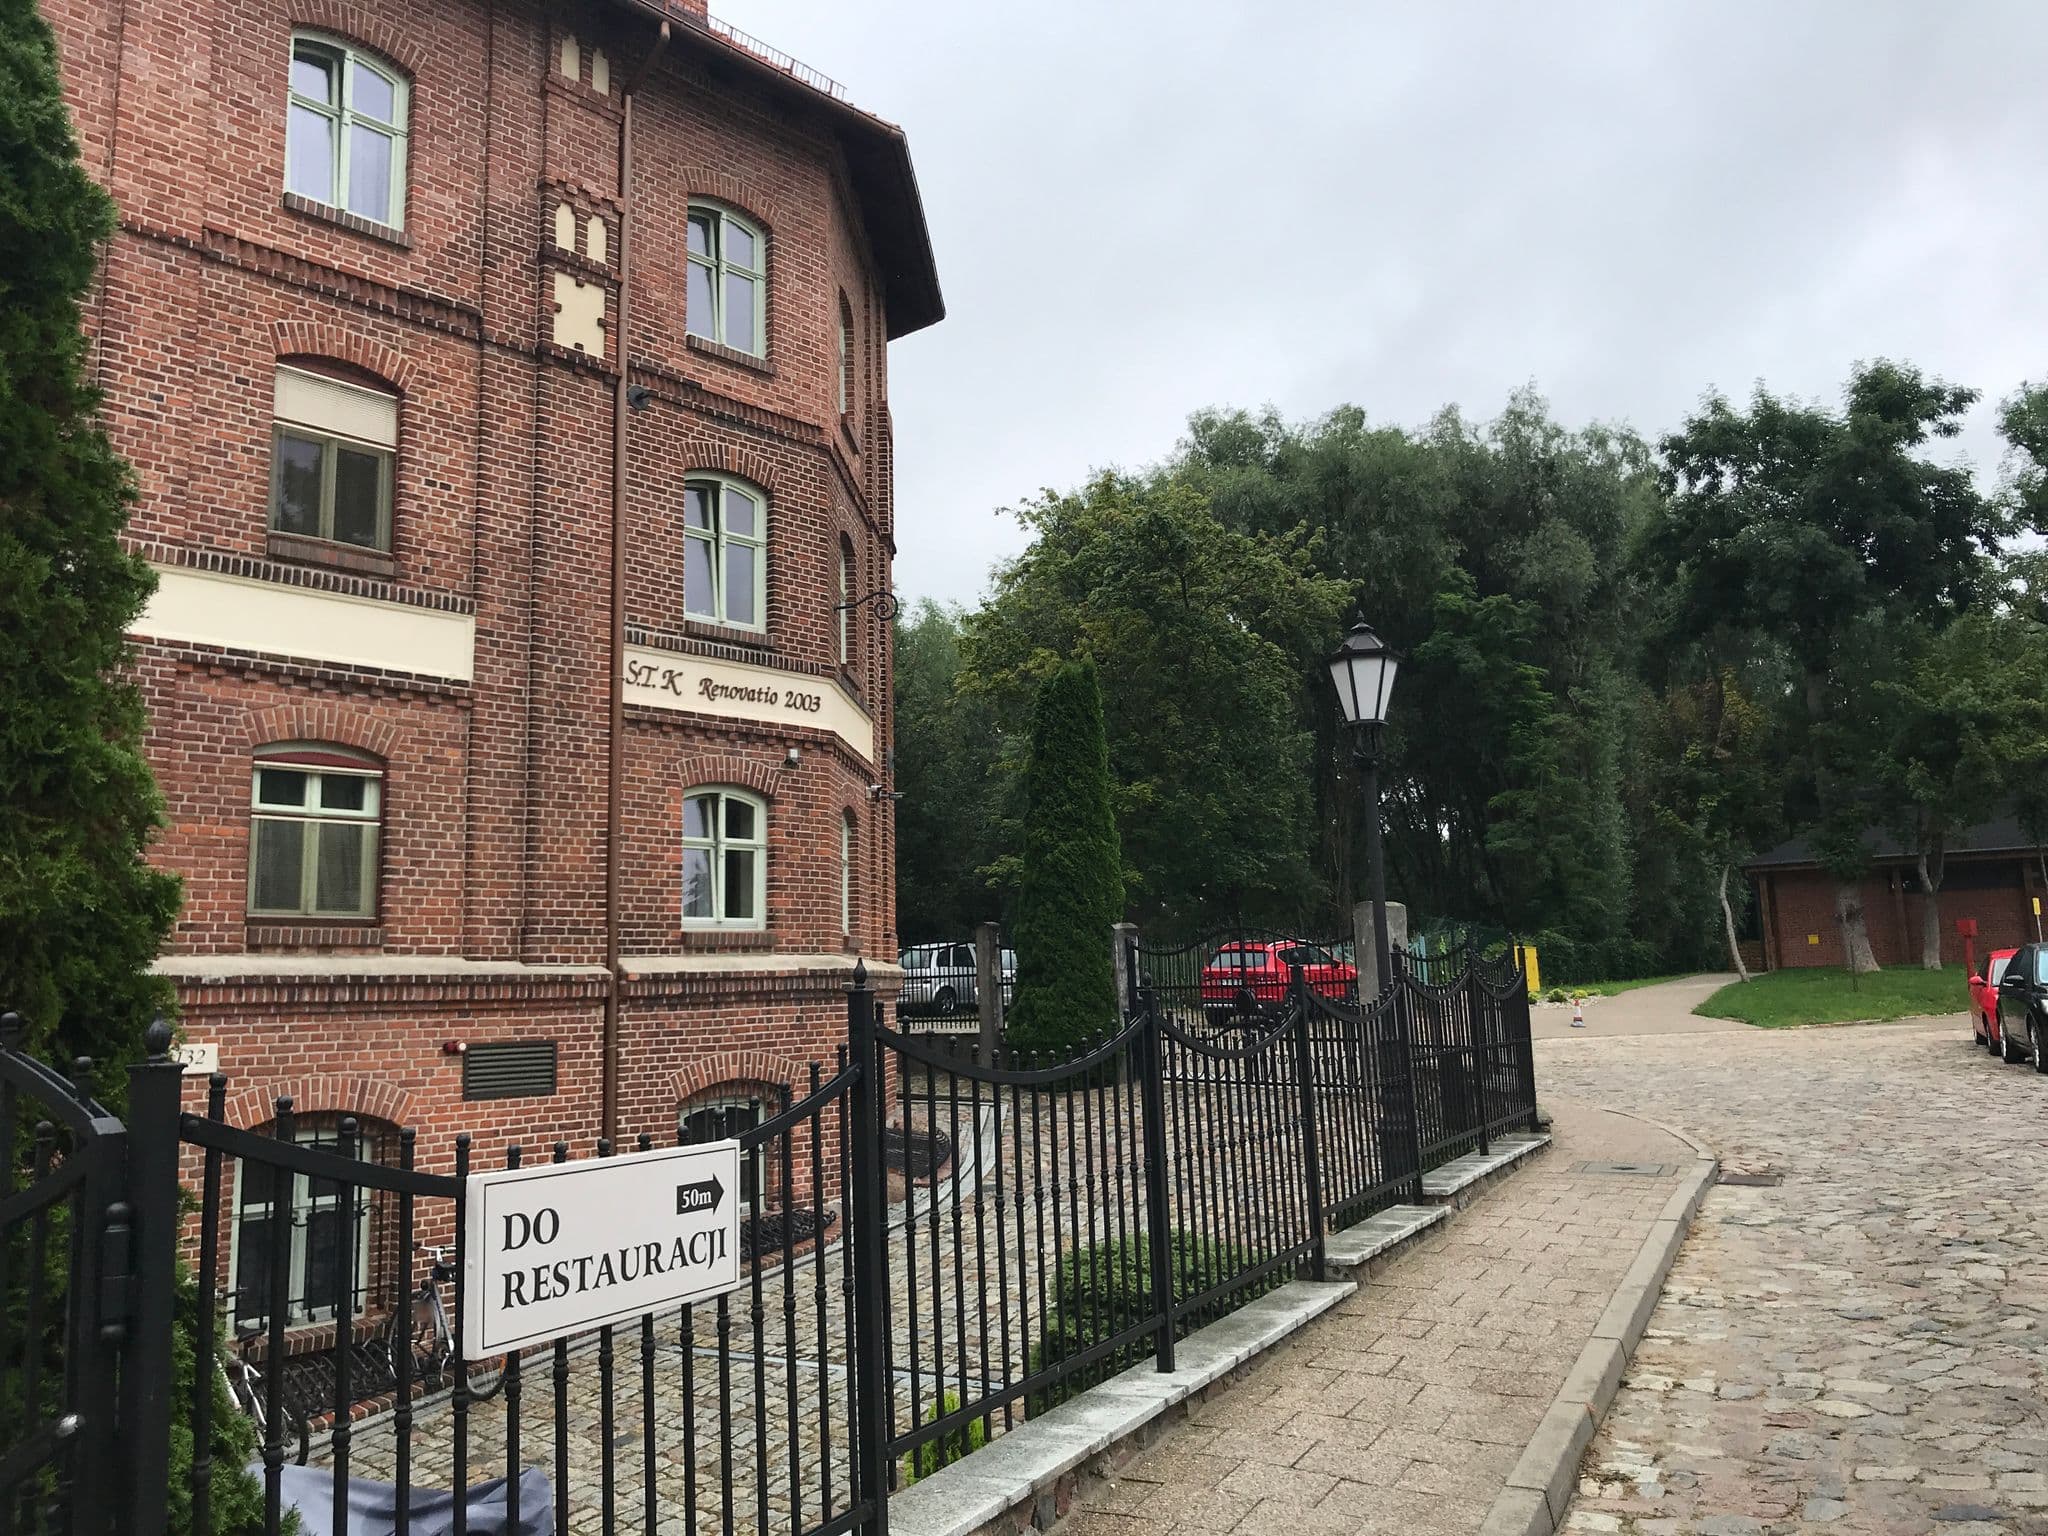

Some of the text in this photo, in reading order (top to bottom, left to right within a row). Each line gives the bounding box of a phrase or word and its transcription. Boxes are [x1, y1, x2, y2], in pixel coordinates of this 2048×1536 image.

[698, 677, 778, 706] Renovatio
[784, 690, 821, 713] 2003
[681, 1188, 712, 1210] 50m
[502, 1208, 560, 1251] DO
[501, 1227, 728, 1310] RESTAURACJI
